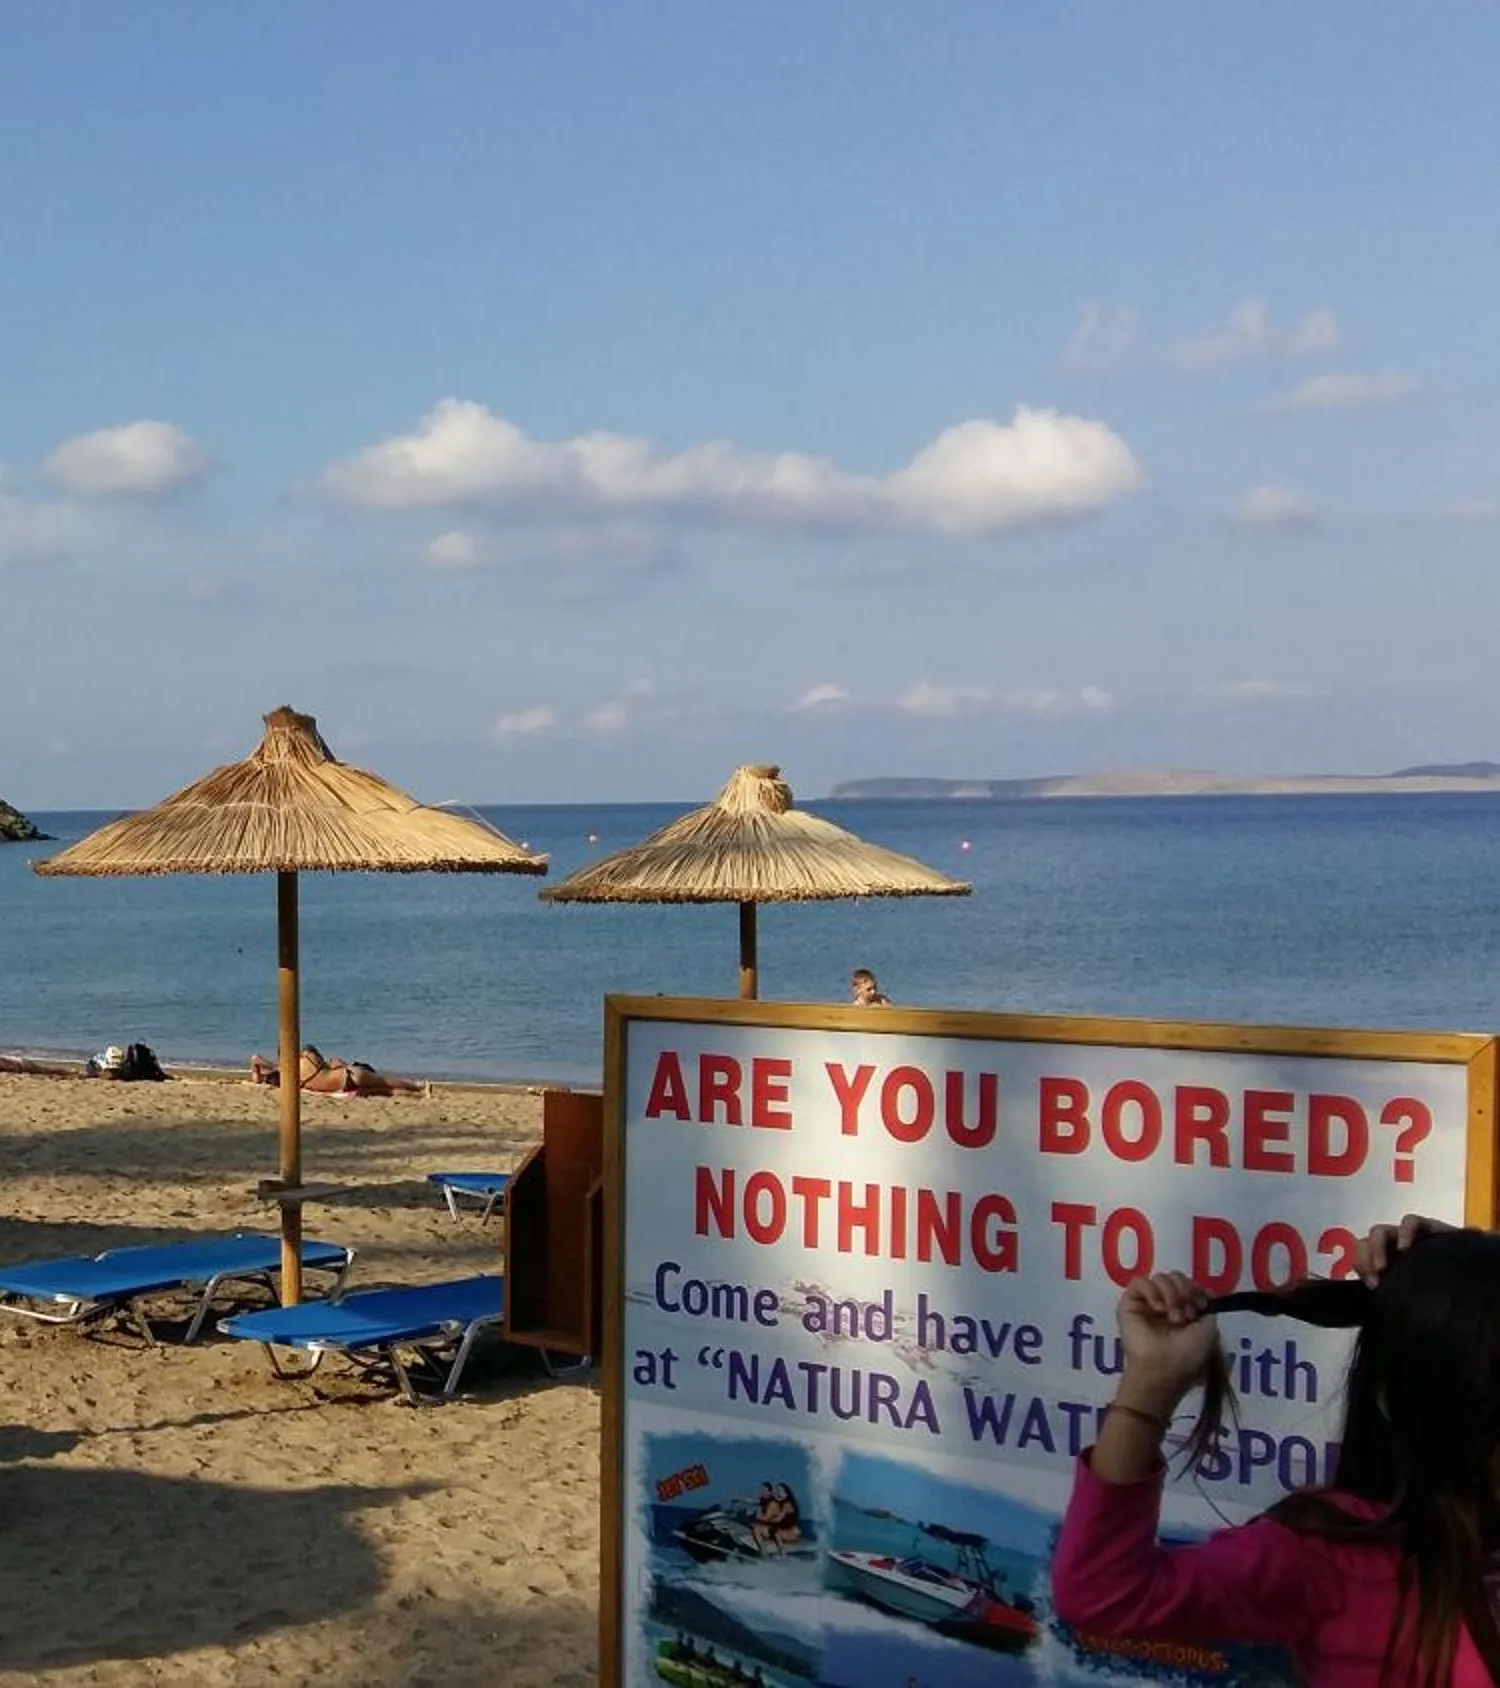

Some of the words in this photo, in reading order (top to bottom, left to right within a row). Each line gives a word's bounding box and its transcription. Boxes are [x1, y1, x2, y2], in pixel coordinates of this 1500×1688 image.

[645, 1051, 792, 1131] ARE
[825, 1061, 998, 1149] YOU
[1039, 1076, 1433, 1183] BORED?
[695, 1166, 1018, 1273] NOTHING
[1051, 1201, 1155, 1288] TO
[1192, 1216, 1358, 1293] DO?
[654, 1261, 780, 1327] Come
[802, 1289, 893, 1343] and
[917, 1293, 1043, 1366] have
[1068, 1313, 1124, 1376] fu
[1228, 1337, 1318, 1403] ith
[633, 1347, 679, 1389] at
[963, 1387, 1105, 1457] WAT
[1194, 1425, 1341, 1493] SPO
